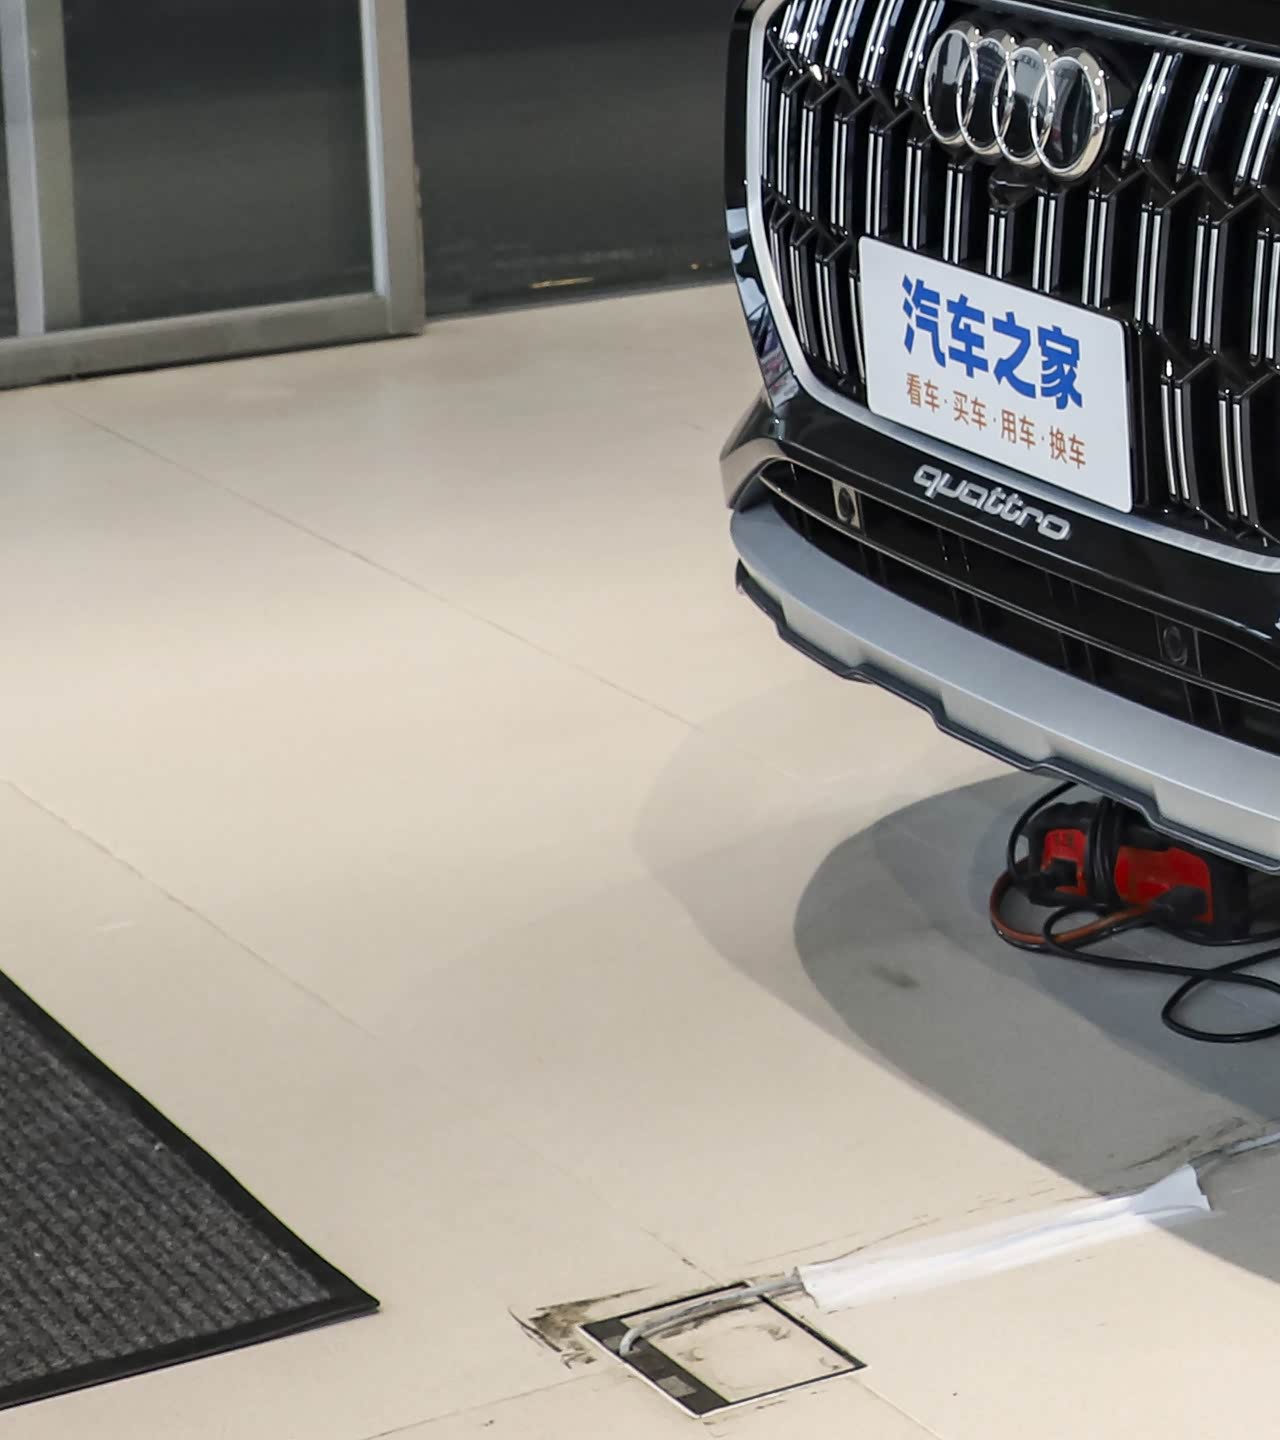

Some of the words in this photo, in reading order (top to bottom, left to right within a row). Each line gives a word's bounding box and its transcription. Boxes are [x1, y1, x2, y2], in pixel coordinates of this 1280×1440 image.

[902, 274, 1083, 410] 汽车之家
[913, 464, 1072, 541] quattro
